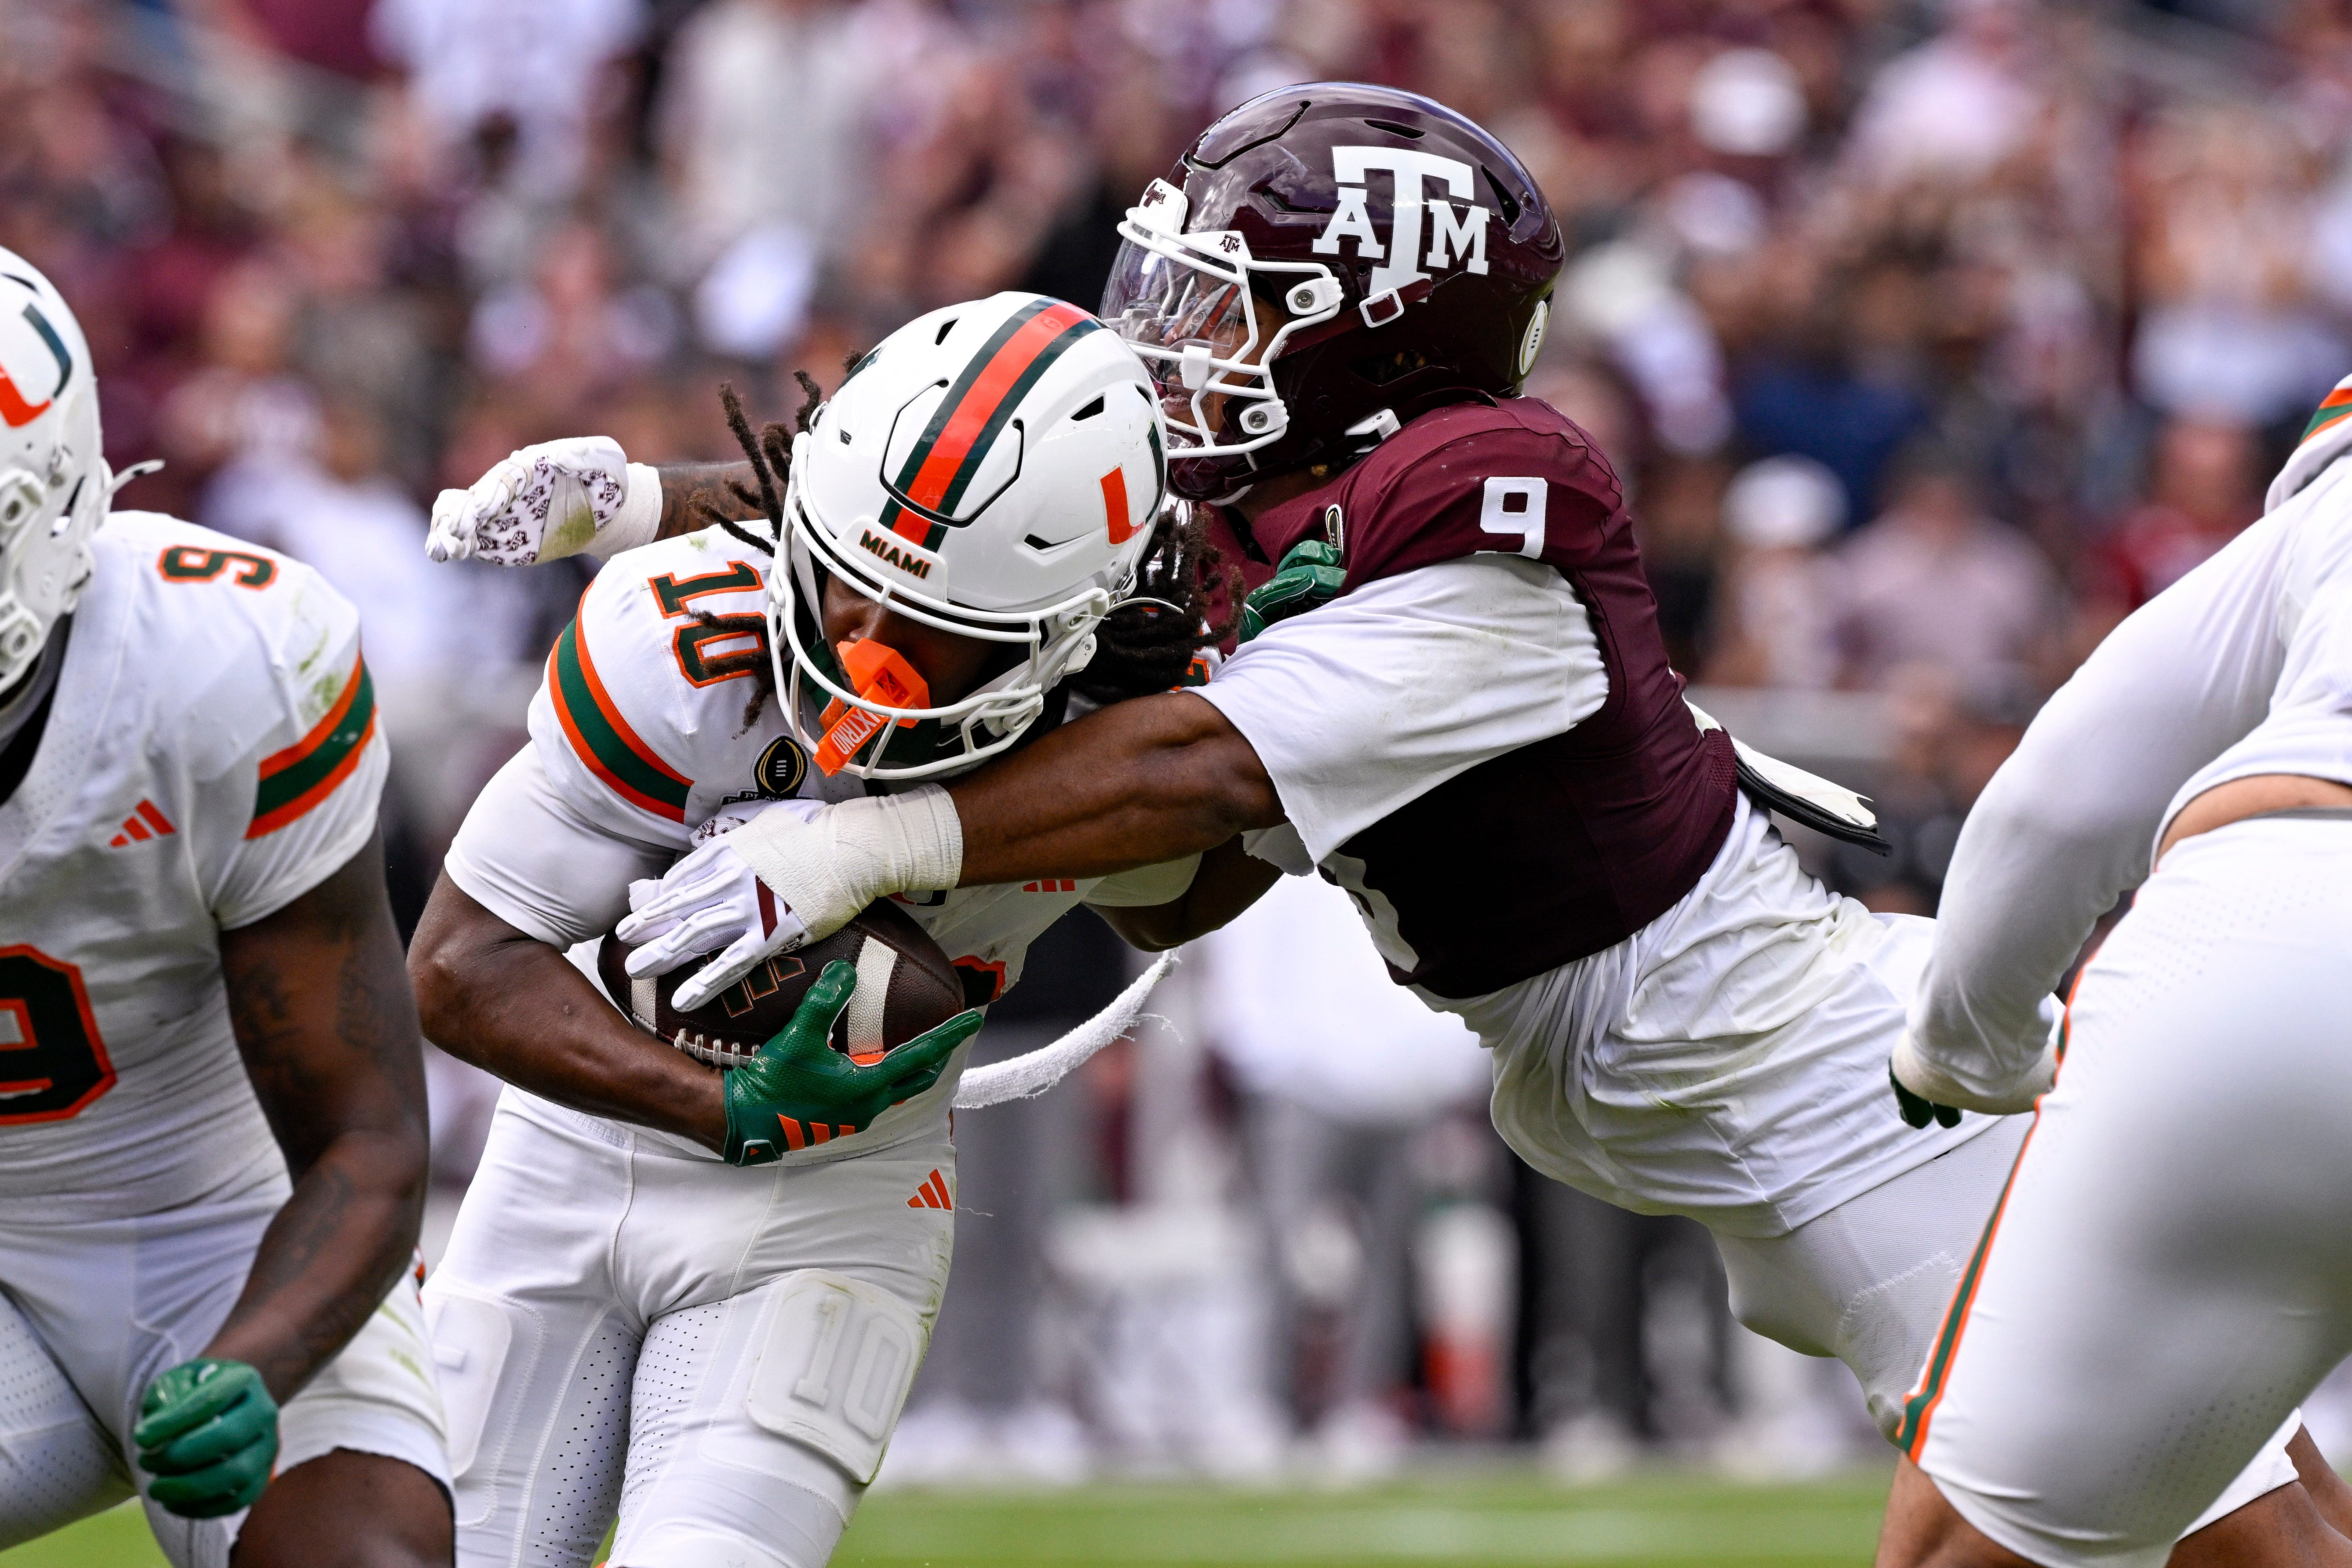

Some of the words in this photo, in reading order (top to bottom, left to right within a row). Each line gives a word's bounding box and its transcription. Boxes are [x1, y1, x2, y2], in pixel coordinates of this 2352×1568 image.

[157, 545, 279, 591] 9
[859, 528, 932, 579] MIAMI
[1480, 477, 1548, 559] 9
[647, 560, 767, 689] 10
[0, 943, 117, 1126] 9
[791, 1292, 914, 1441] 10
